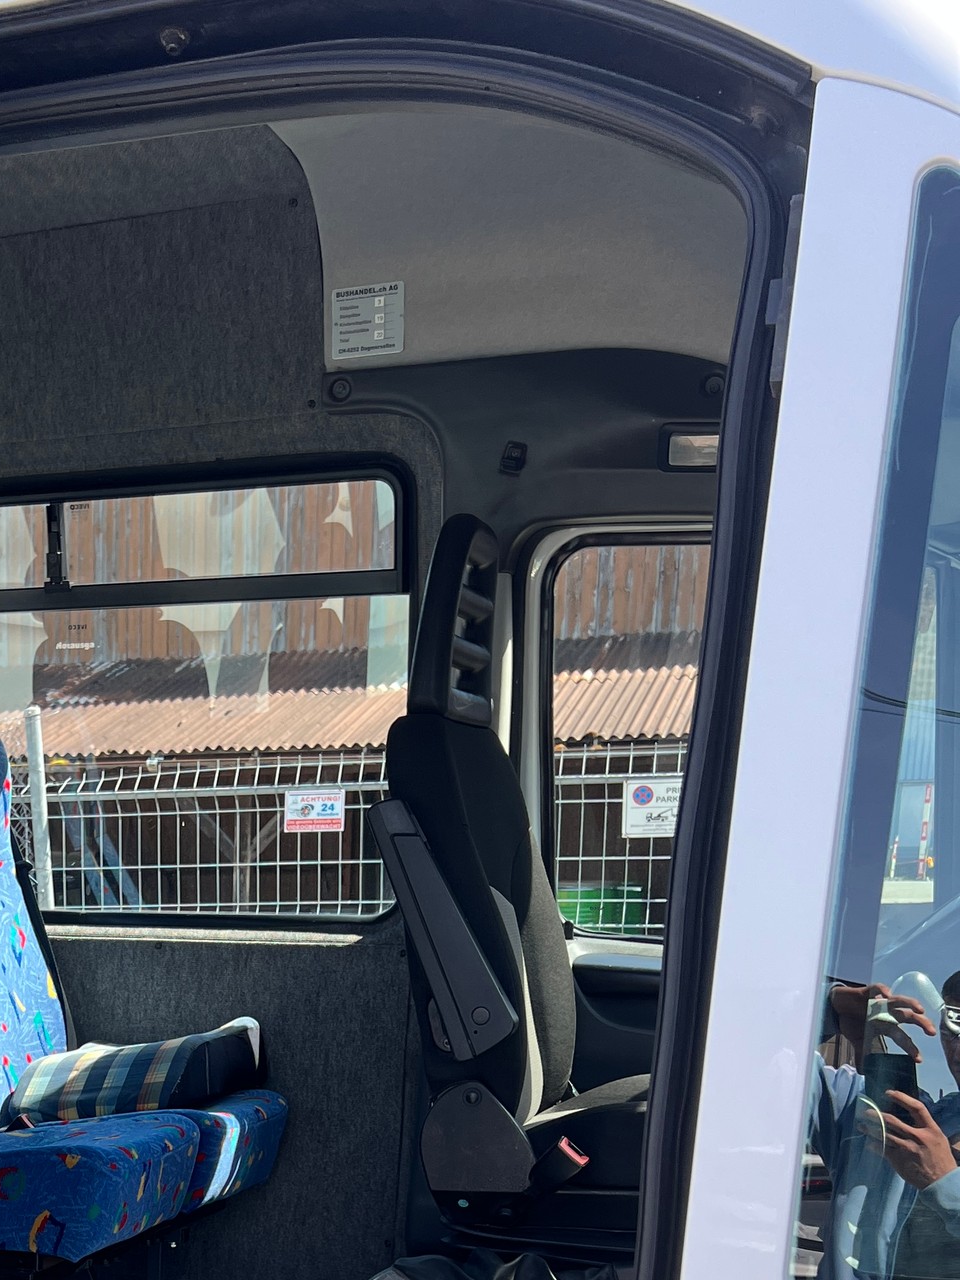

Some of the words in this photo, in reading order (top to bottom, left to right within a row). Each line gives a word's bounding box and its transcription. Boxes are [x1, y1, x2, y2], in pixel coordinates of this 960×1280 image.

[665, 786, 681, 794] PRI
[300, 795, 341, 803] ACHTUNG!
[321, 803, 335, 812] 24
